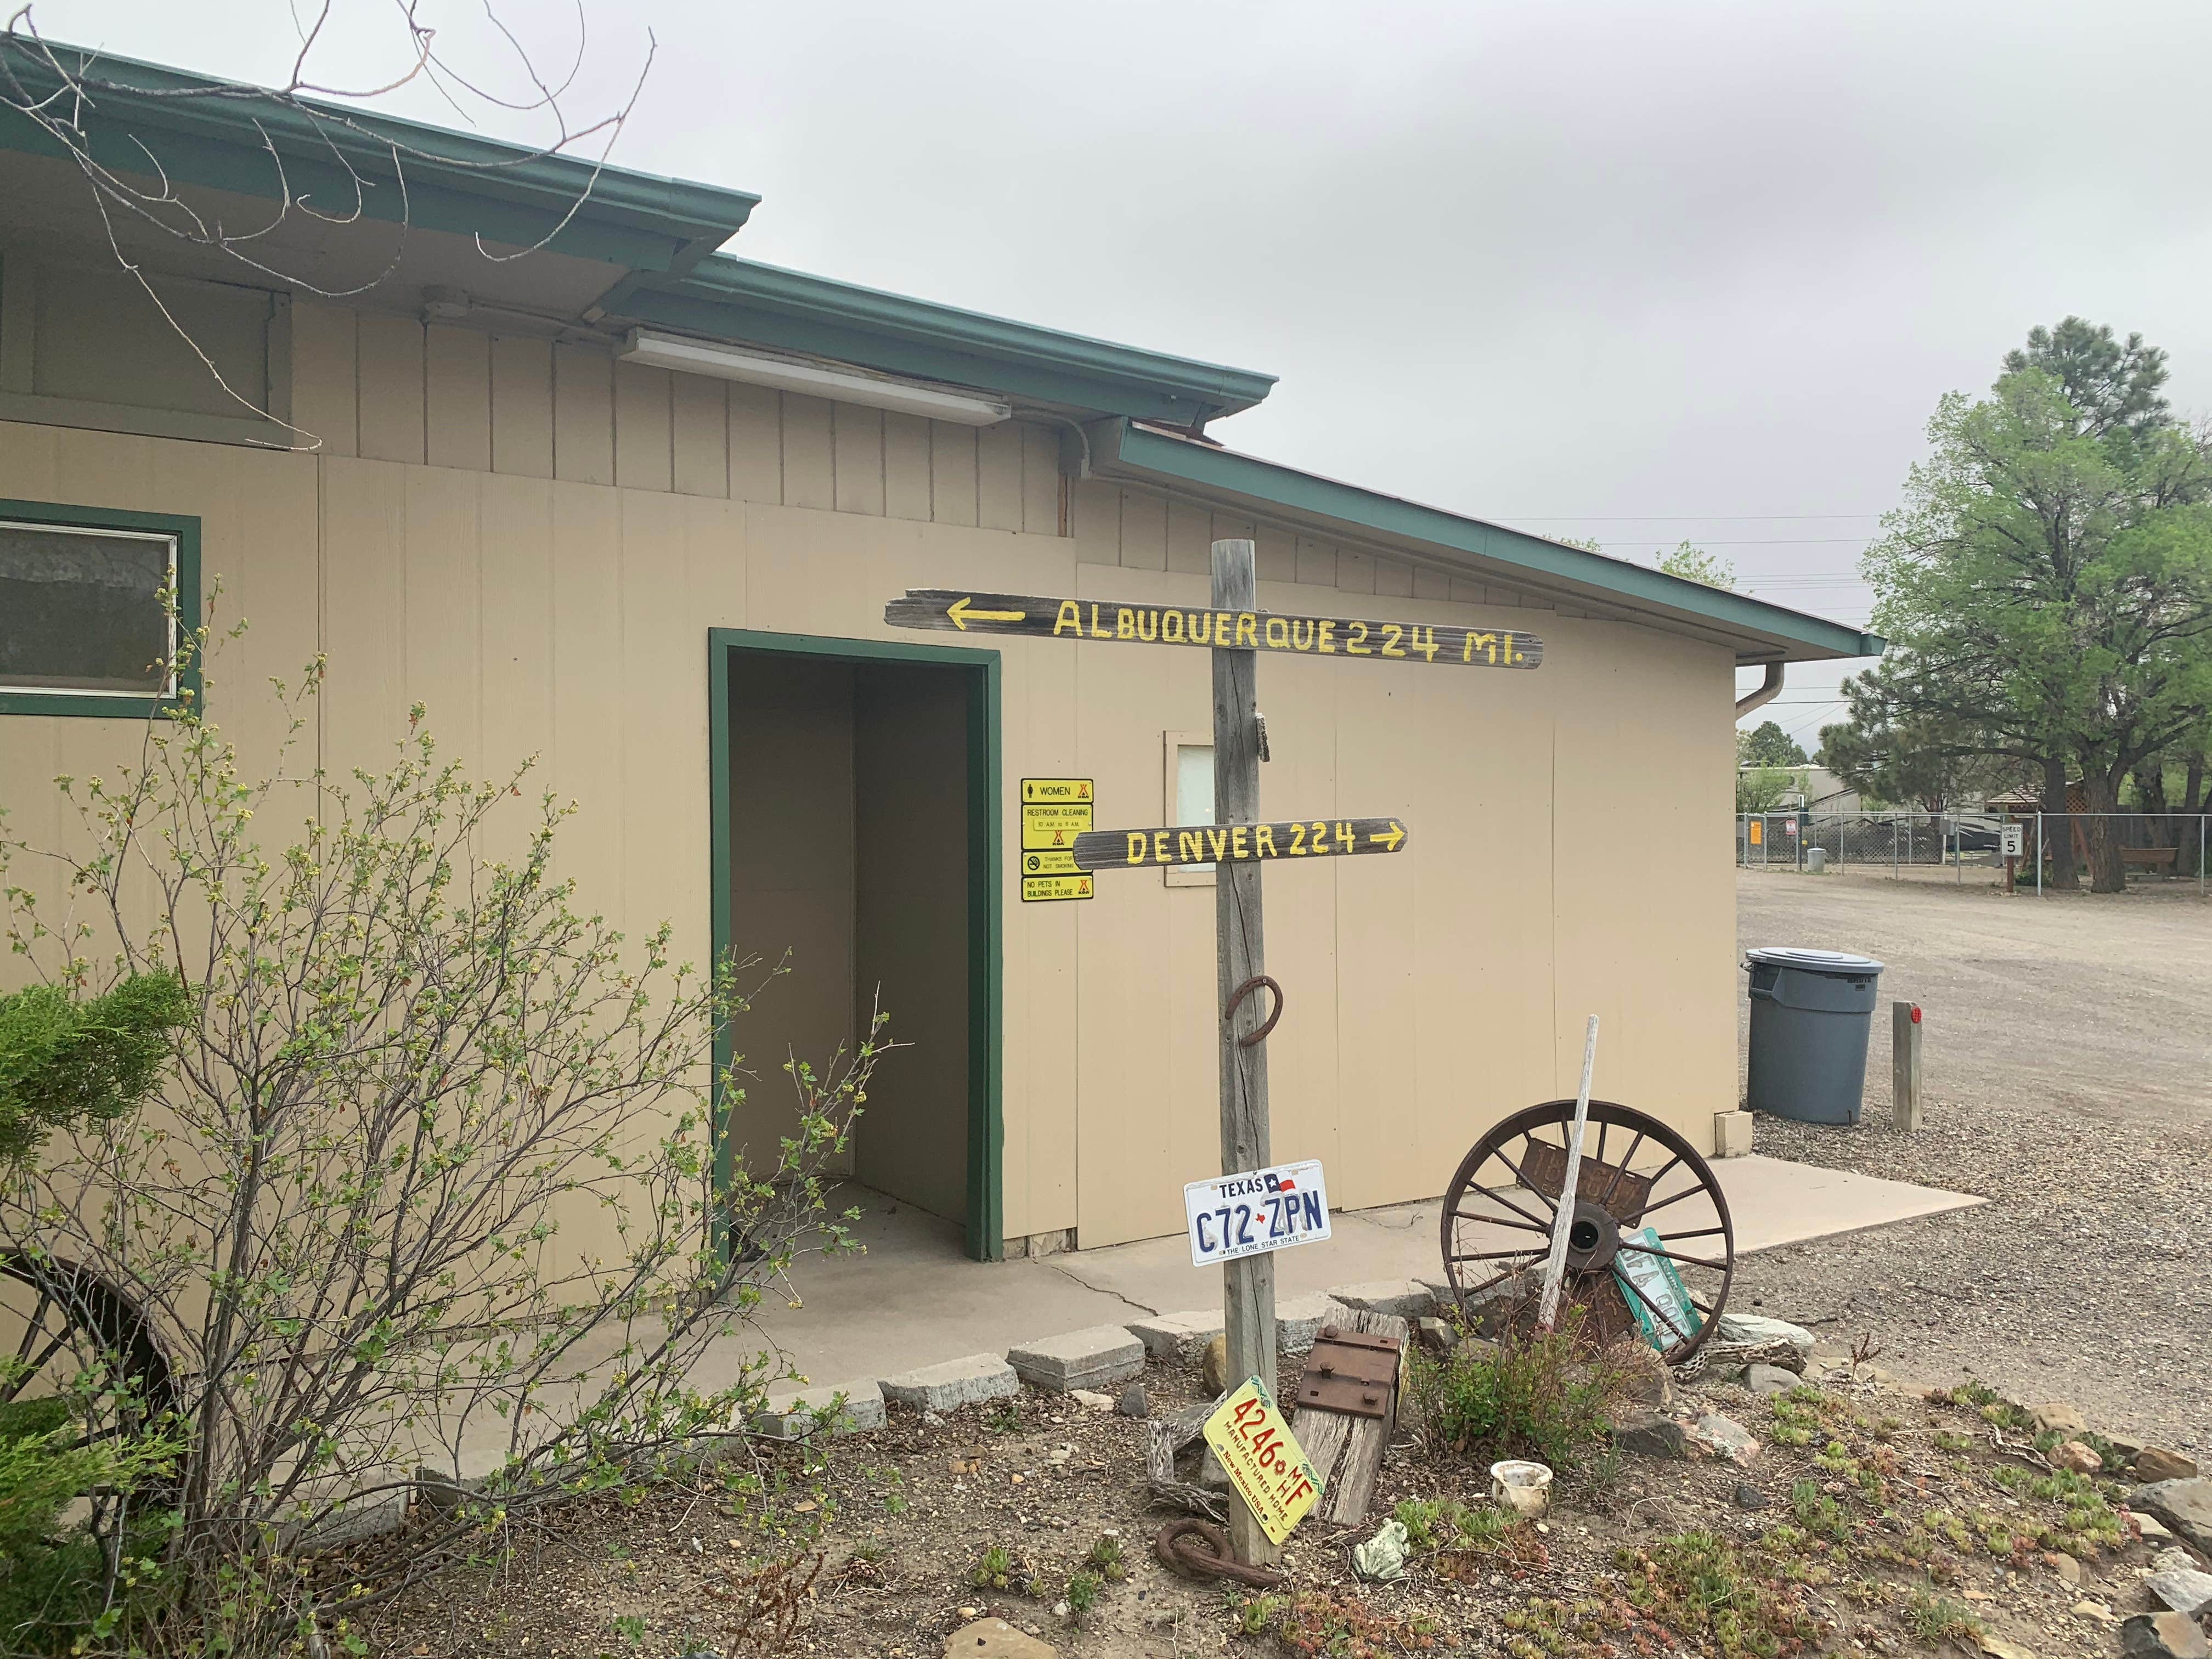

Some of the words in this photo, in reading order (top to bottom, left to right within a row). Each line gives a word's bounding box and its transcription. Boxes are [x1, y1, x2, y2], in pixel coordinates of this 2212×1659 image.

[1053, 600, 1338, 653] ALBUQUERQUE
[1346, 622, 1440, 662] 224
[1463, 631, 1524, 665] MI.
[1040, 787, 1070, 795] WOMEN
[1126, 825, 1278, 864] DENVER
[1289, 822, 1356, 855] 224
[2007, 840, 2016, 853] 5
[1219, 1178, 1263, 1199] TEXAS
[1196, 1204, 1255, 1252] C72
[1265, 1190, 1323, 1238] ZPN
[1242, 1244, 1259, 1252] LONE
[1261, 1240, 1277, 1248] STAR
[1280, 1235, 1300, 1244] STATE
[1233, 1397, 1285, 1469] 4246
[1223, 1420, 1271, 1493] MANUFACTURED
[1268, 1492, 1289, 1522] HOME
[1223, 1450, 1235, 1470] New
[1233, 1466, 1252, 1497] Mexico
[1251, 1494, 1264, 1515] USA
